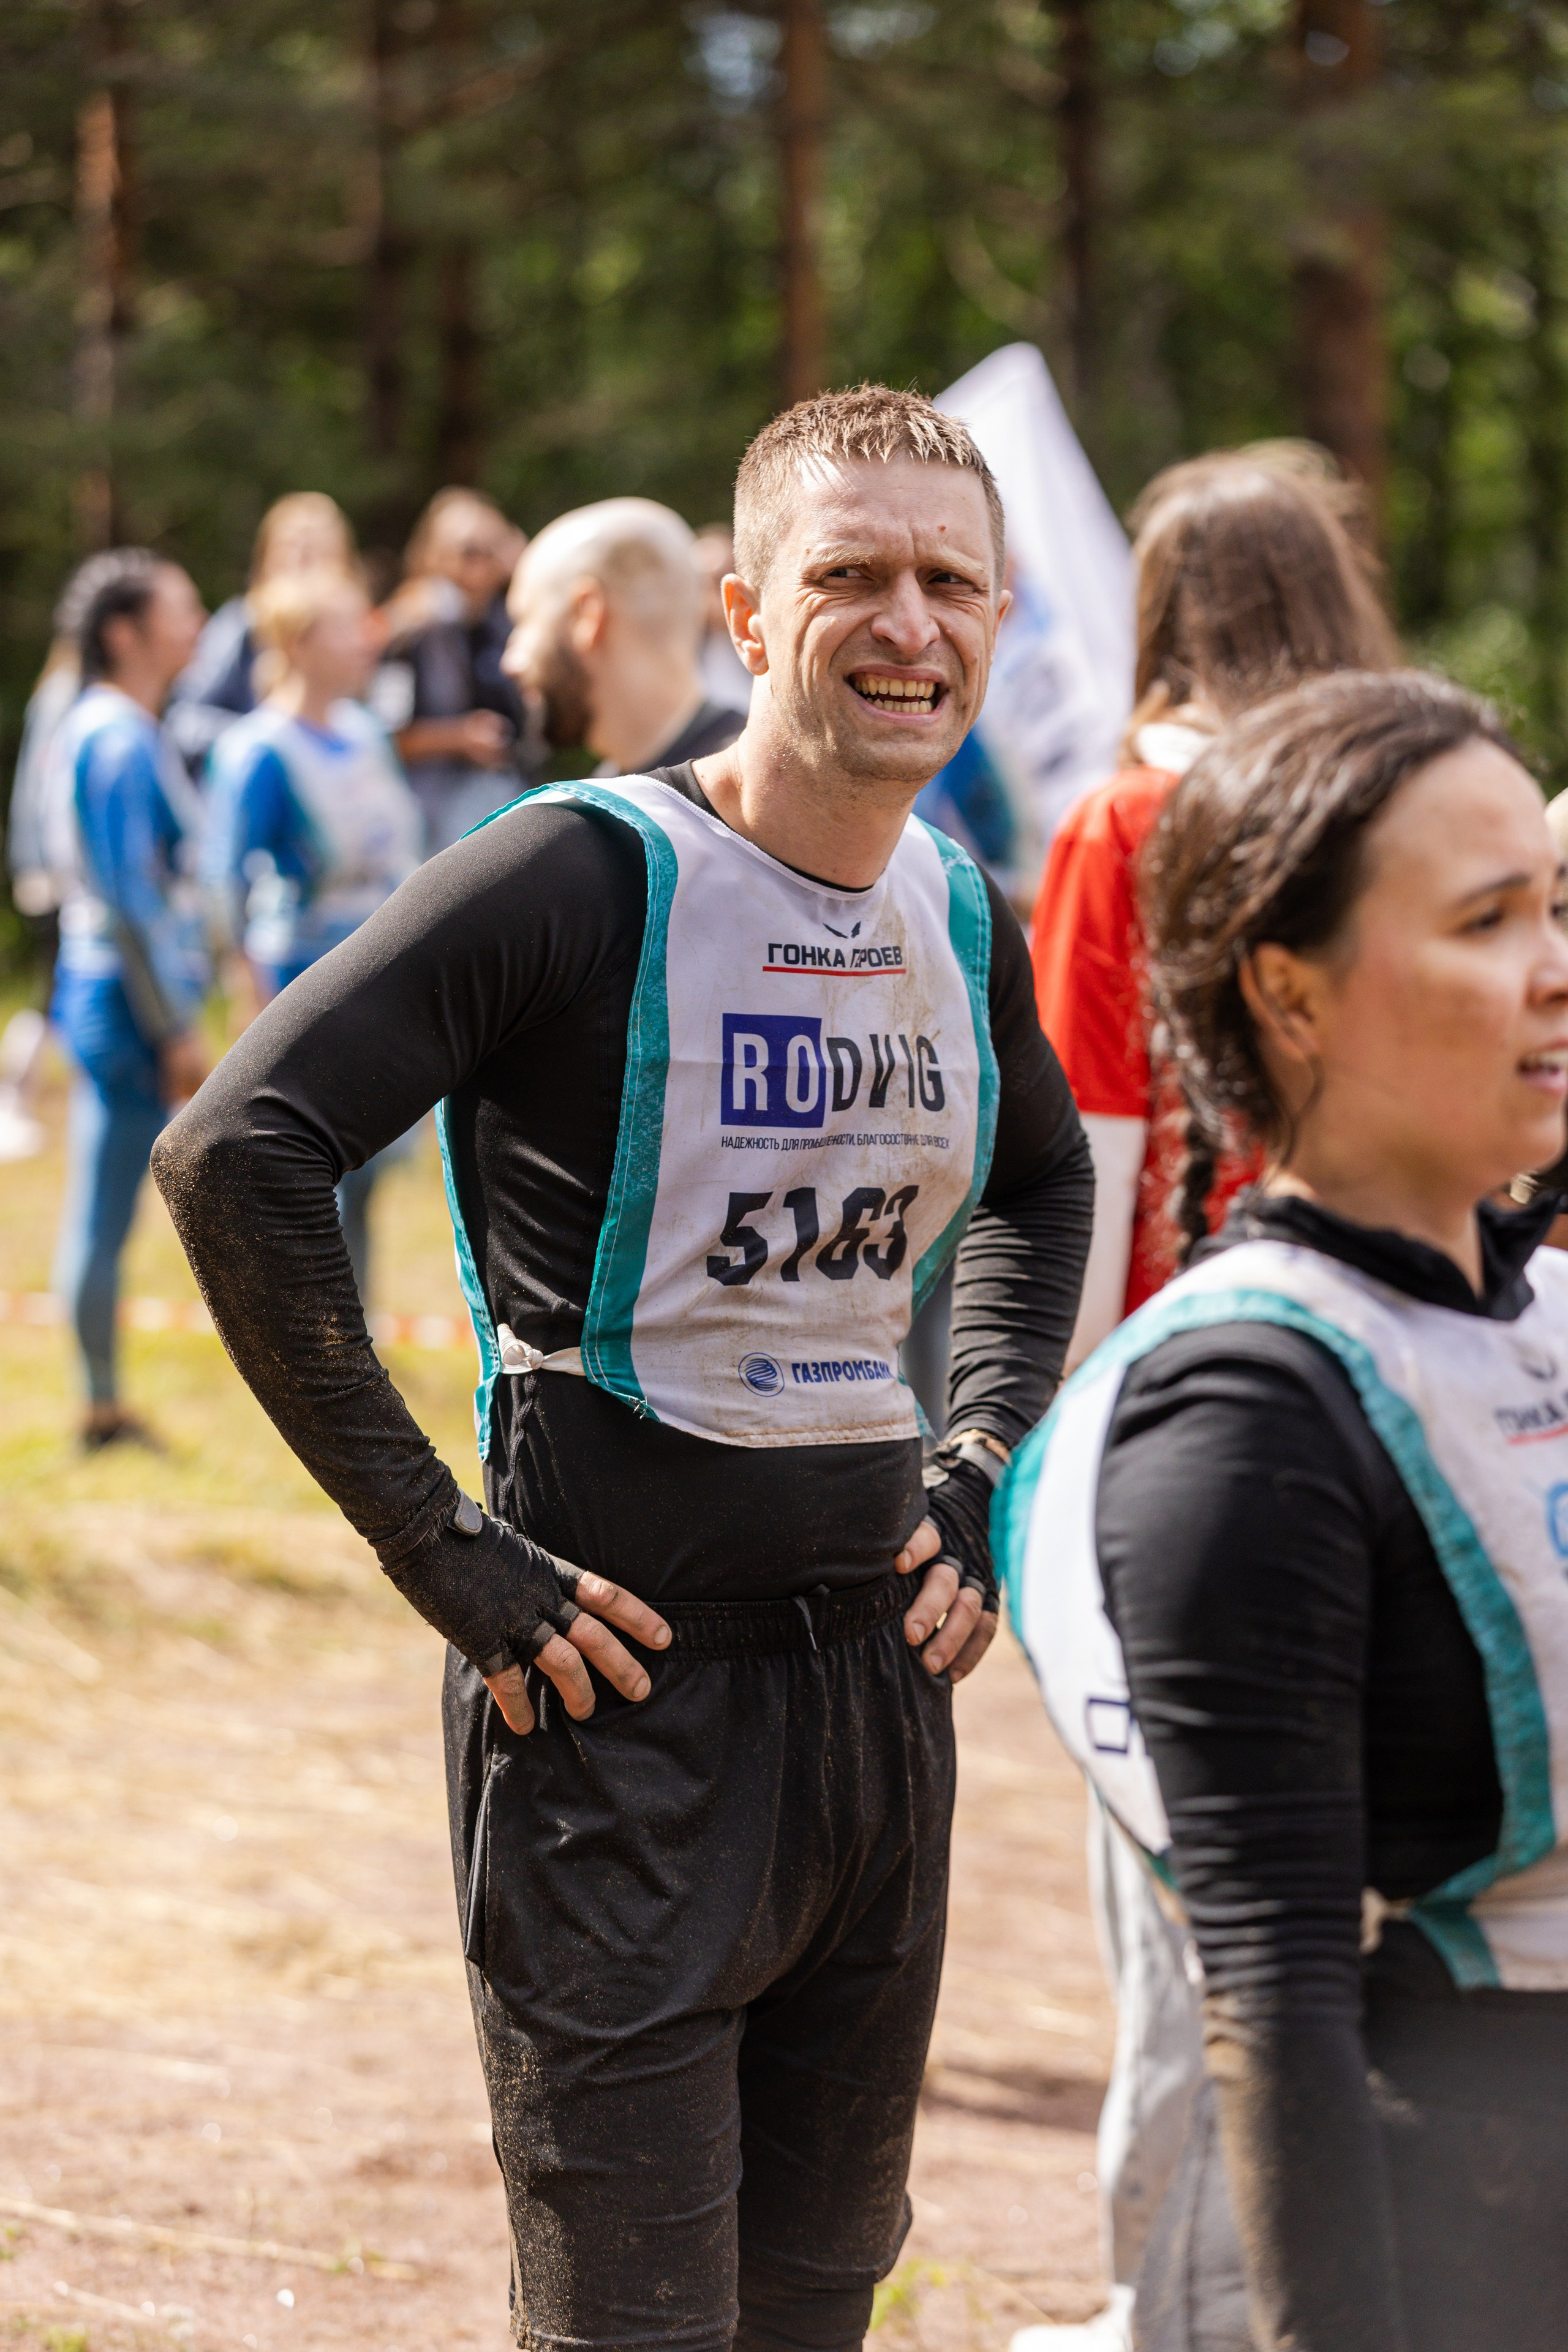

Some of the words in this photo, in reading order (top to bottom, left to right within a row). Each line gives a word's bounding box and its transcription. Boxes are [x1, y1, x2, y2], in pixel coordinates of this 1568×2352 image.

[768, 943, 846, 968] ГОНКА
[850, 945, 903, 968] ГРОЕВ
[733, 1033, 946, 1112] RODVIG
[722, 1136, 780, 1149] НАДЕЖНОСТЬ
[781, 1138, 799, 1151] ДЛЯ
[706, 1185, 919, 1286] 5163
